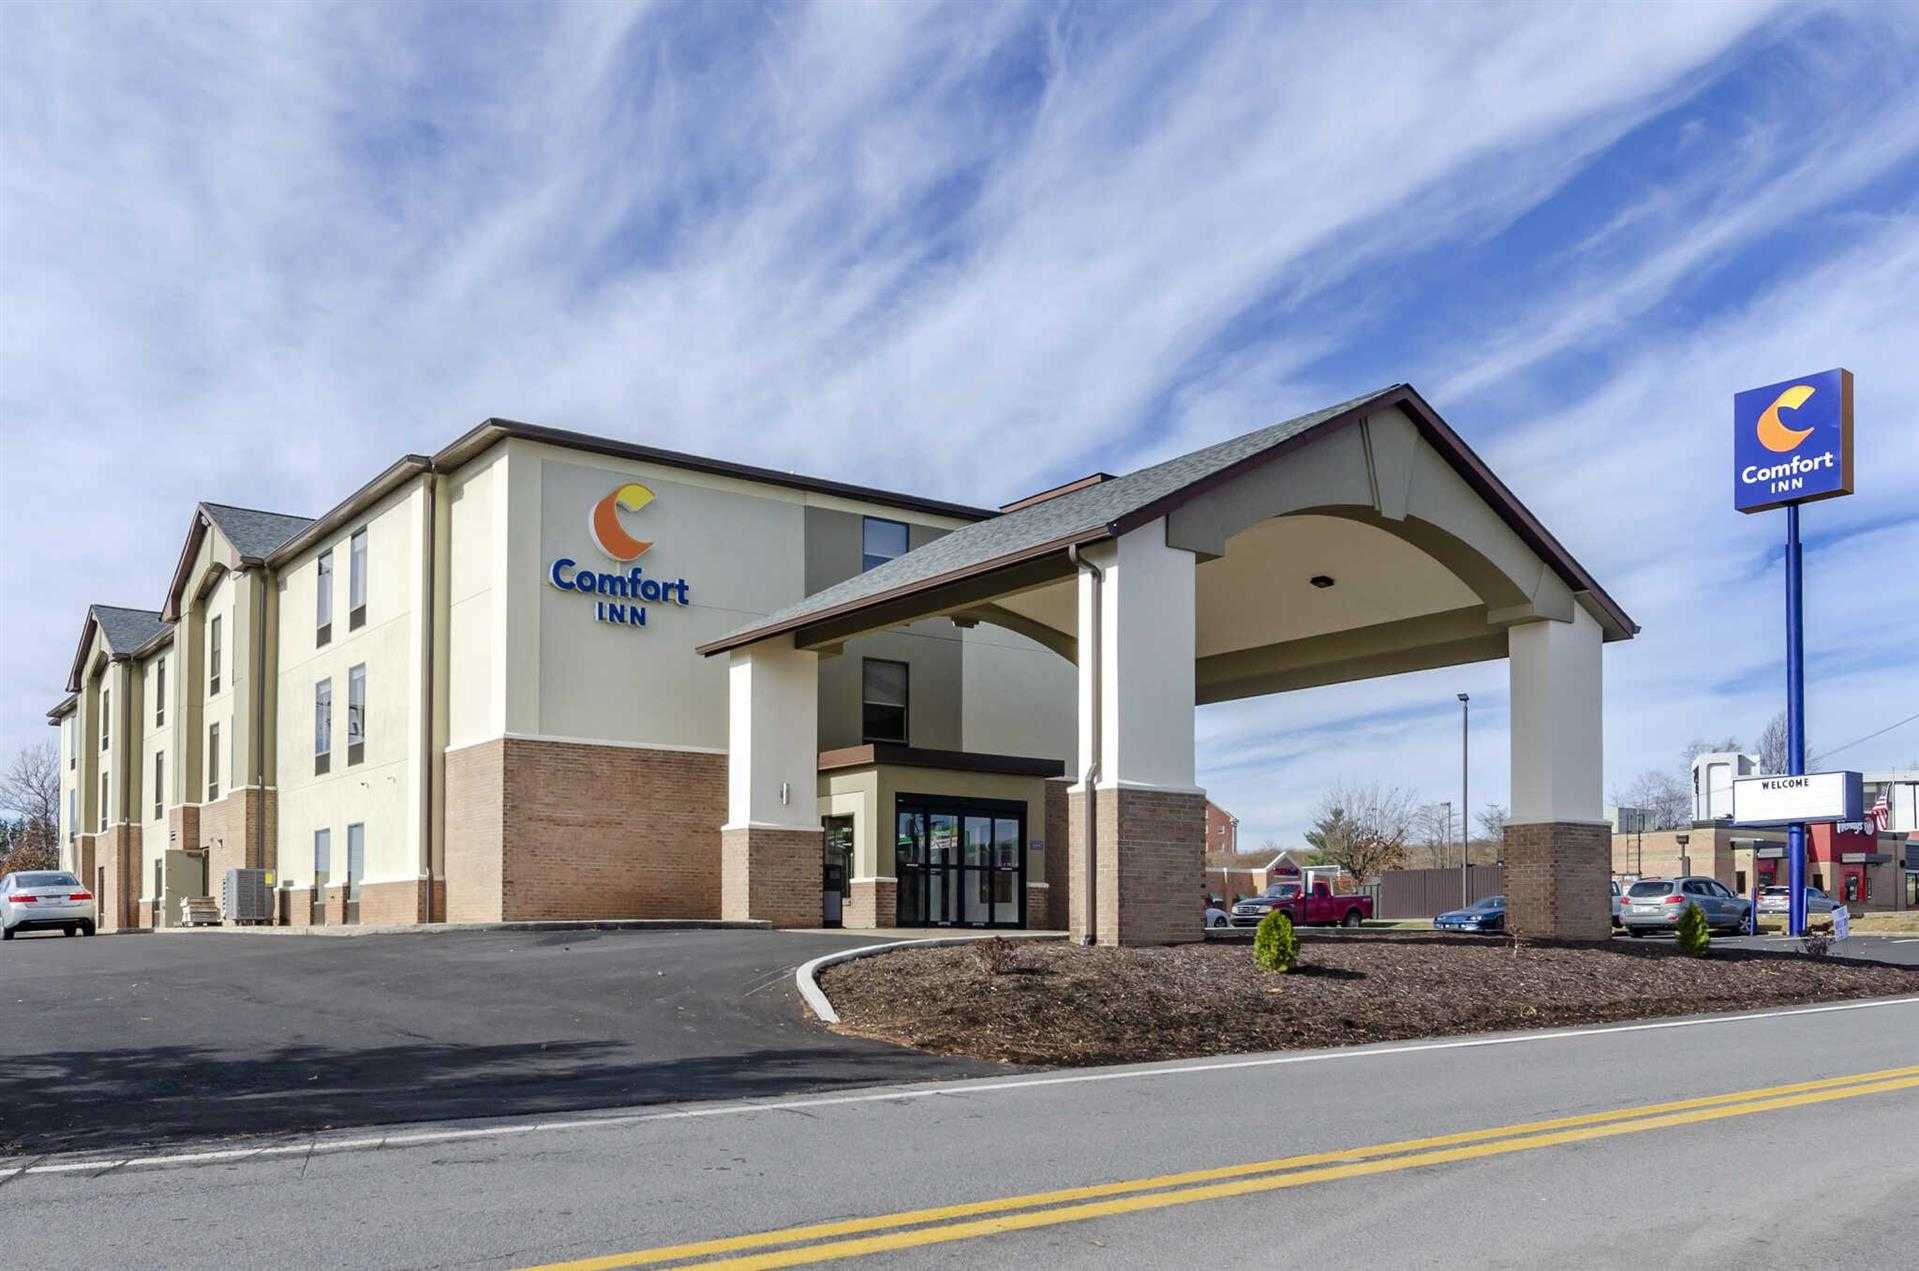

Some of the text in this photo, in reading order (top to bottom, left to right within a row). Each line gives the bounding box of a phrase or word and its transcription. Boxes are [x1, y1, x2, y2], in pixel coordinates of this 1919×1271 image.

[1742, 451, 1834, 484] Comfort
[1771, 477, 1804, 494] INN
[550, 558, 690, 606] Comfort
[596, 602, 646, 626] INN
[1761, 778, 1809, 790] WELCOME
